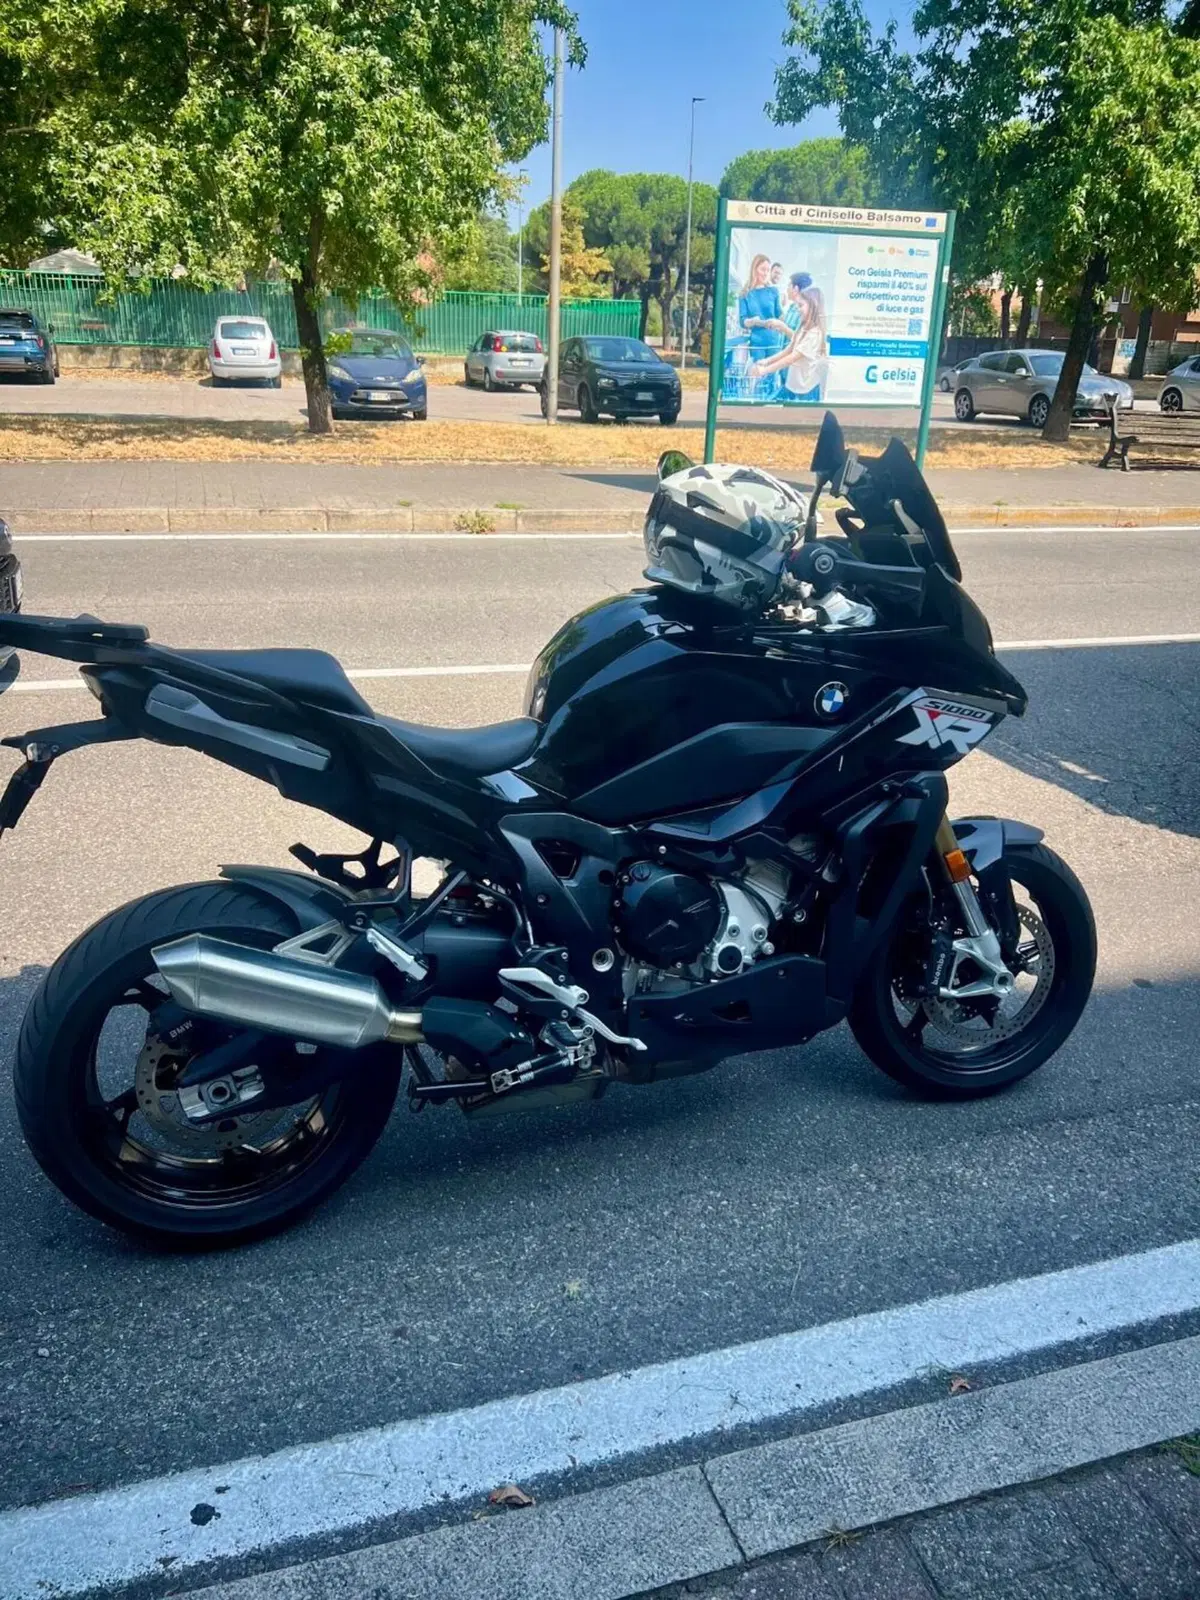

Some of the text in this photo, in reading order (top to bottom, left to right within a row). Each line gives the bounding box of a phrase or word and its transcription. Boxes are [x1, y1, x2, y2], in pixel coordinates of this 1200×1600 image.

[755, 204, 785, 216] Città
[790, 207, 803, 217] di
[806, 208, 863, 221] Cinisello
[867, 211, 922, 224] Balsamo
[848, 266, 866, 276] Con
[893, 268, 929, 279] Premium
[857, 279, 890, 289] risparmi
[897, 281, 914, 290] 40%
[915, 282, 927, 290] sul
[849, 290, 925, 302] corrispettivo annuo
[876, 303, 884, 312] di
[886, 303, 902, 312] luce
[909, 306, 924, 315] gas
[923, 699, 987, 720] S1000
[895, 706, 993, 755] XR
[930, 952, 946, 986] brembo
[169, 1019, 193, 1038] BMW
